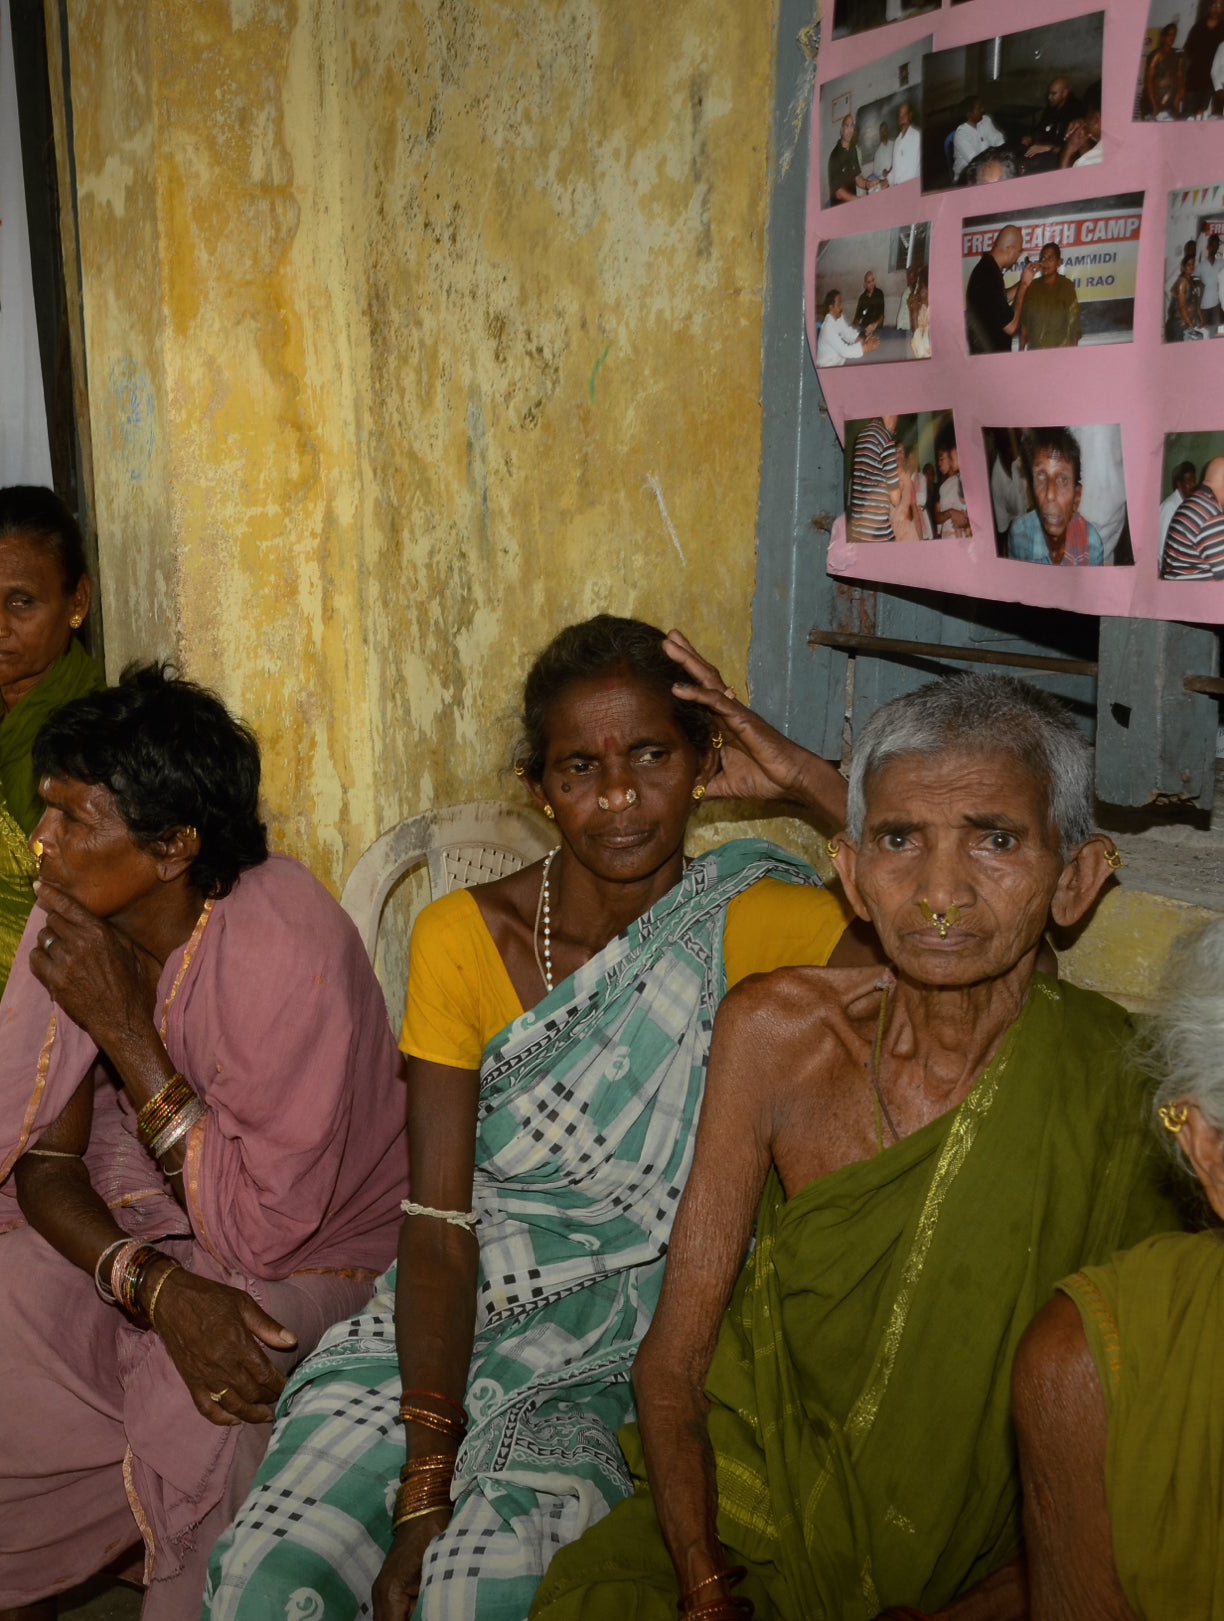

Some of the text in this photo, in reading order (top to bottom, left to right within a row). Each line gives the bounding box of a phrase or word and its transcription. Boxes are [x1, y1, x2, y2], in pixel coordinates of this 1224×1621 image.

[963, 218, 1139, 254] FRE EALTH CAMP
[1086, 275, 1115, 288] RAO
